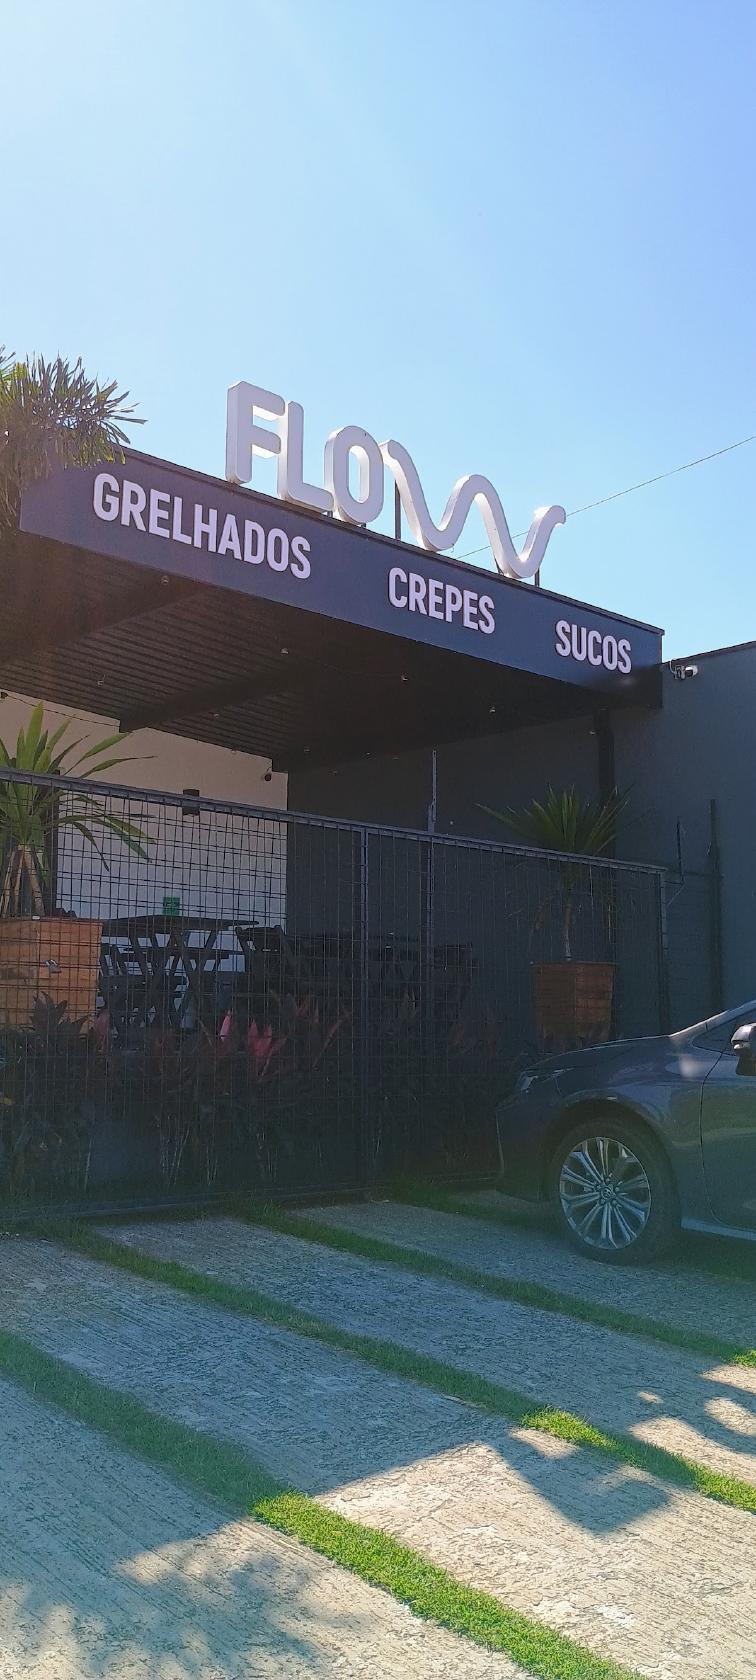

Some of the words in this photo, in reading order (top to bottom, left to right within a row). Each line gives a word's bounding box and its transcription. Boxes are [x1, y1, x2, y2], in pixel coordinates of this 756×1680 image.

[93, 472, 311, 579] GRELHADOS
[387, 567, 496, 635] CREPES
[555, 620, 633, 674] SUCOS
